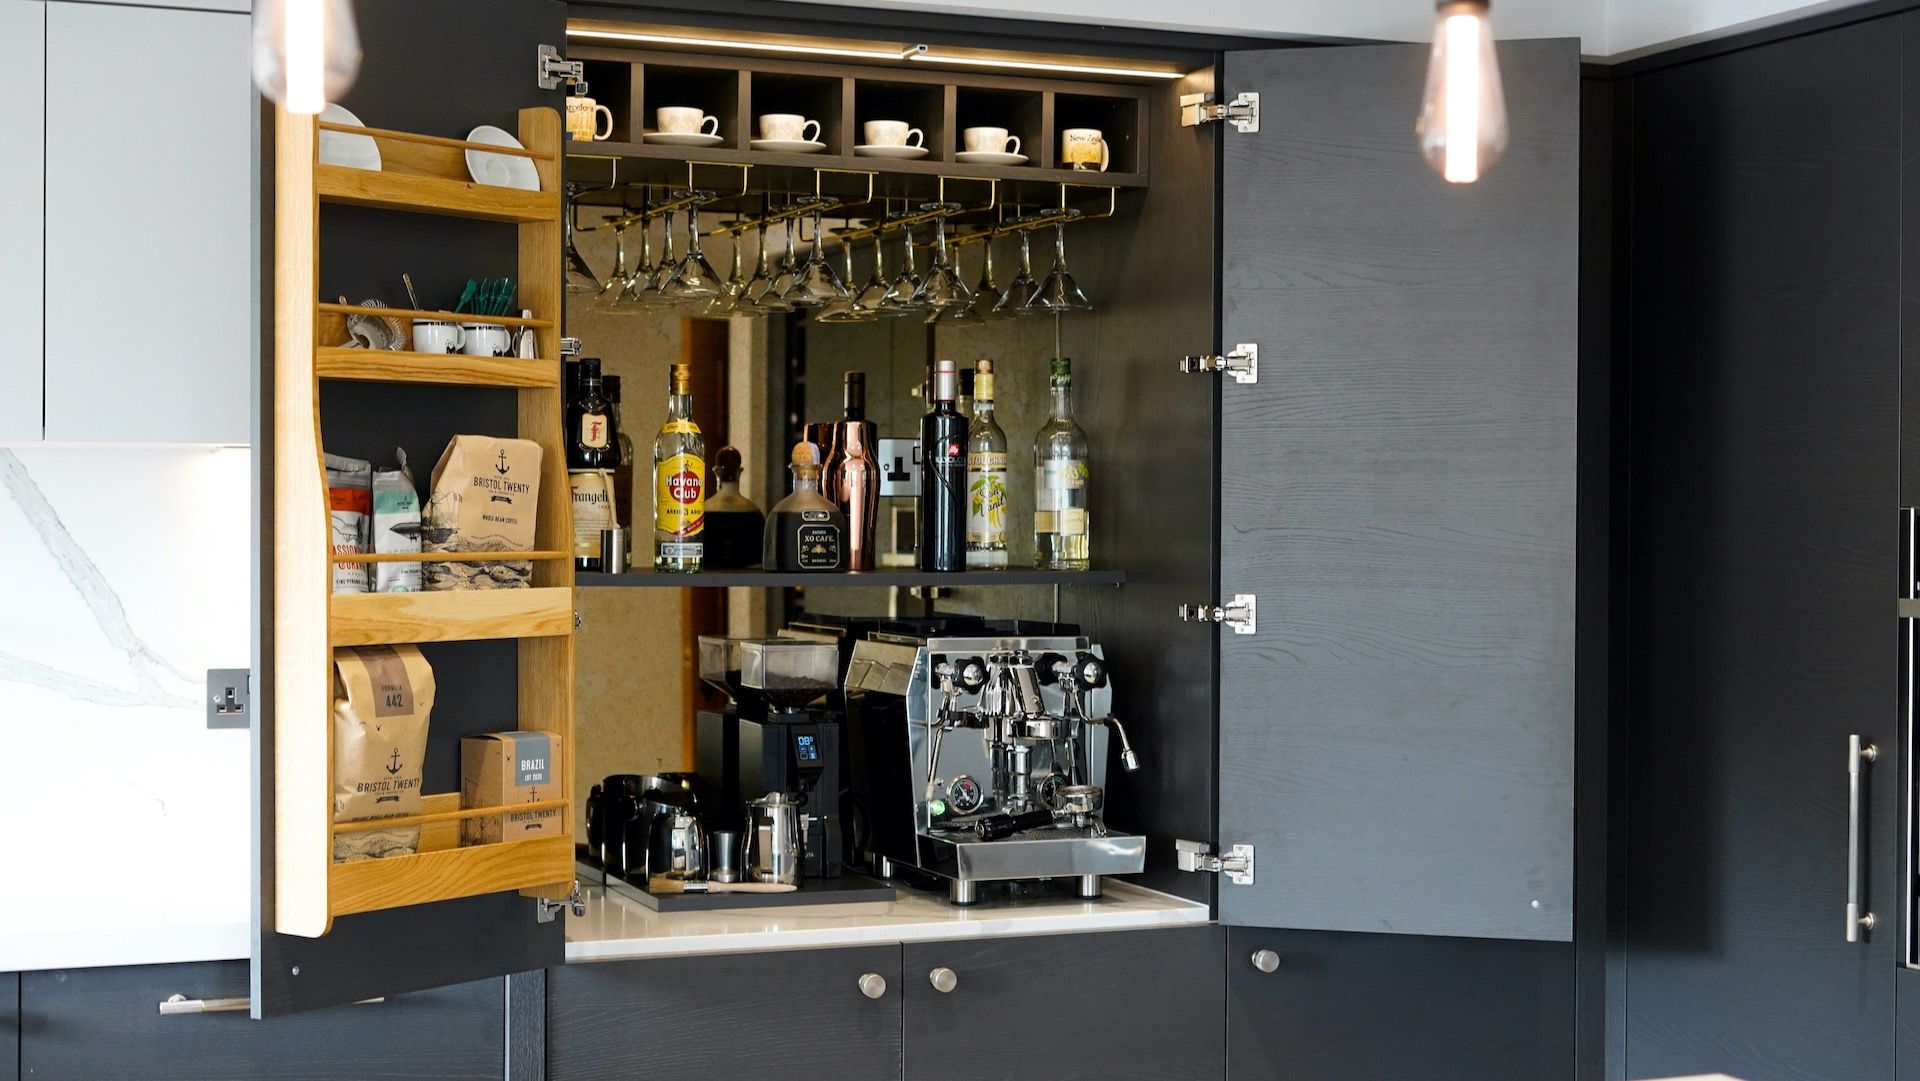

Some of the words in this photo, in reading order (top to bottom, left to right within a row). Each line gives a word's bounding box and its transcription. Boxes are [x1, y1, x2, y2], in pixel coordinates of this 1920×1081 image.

[1070, 134, 1085, 142] New
[473, 476, 501, 490] BRISTOL
[503, 481, 530, 494] TWENTY
[666, 475, 703, 487] Havana
[570, 486, 608, 505] Frangeli
[673, 487, 697, 499] Club
[482, 514, 494, 522] WHOLE
[495, 515, 505, 523] BEAN
[505, 516, 518, 525] COFFEE
[385, 693, 403, 708] 442
[521, 758, 545, 772] BRAZIL
[357, 780, 391, 793] BRISTOL
[510, 812, 534, 822] BRISTOL
[534, 808, 557, 819] TWENTY
